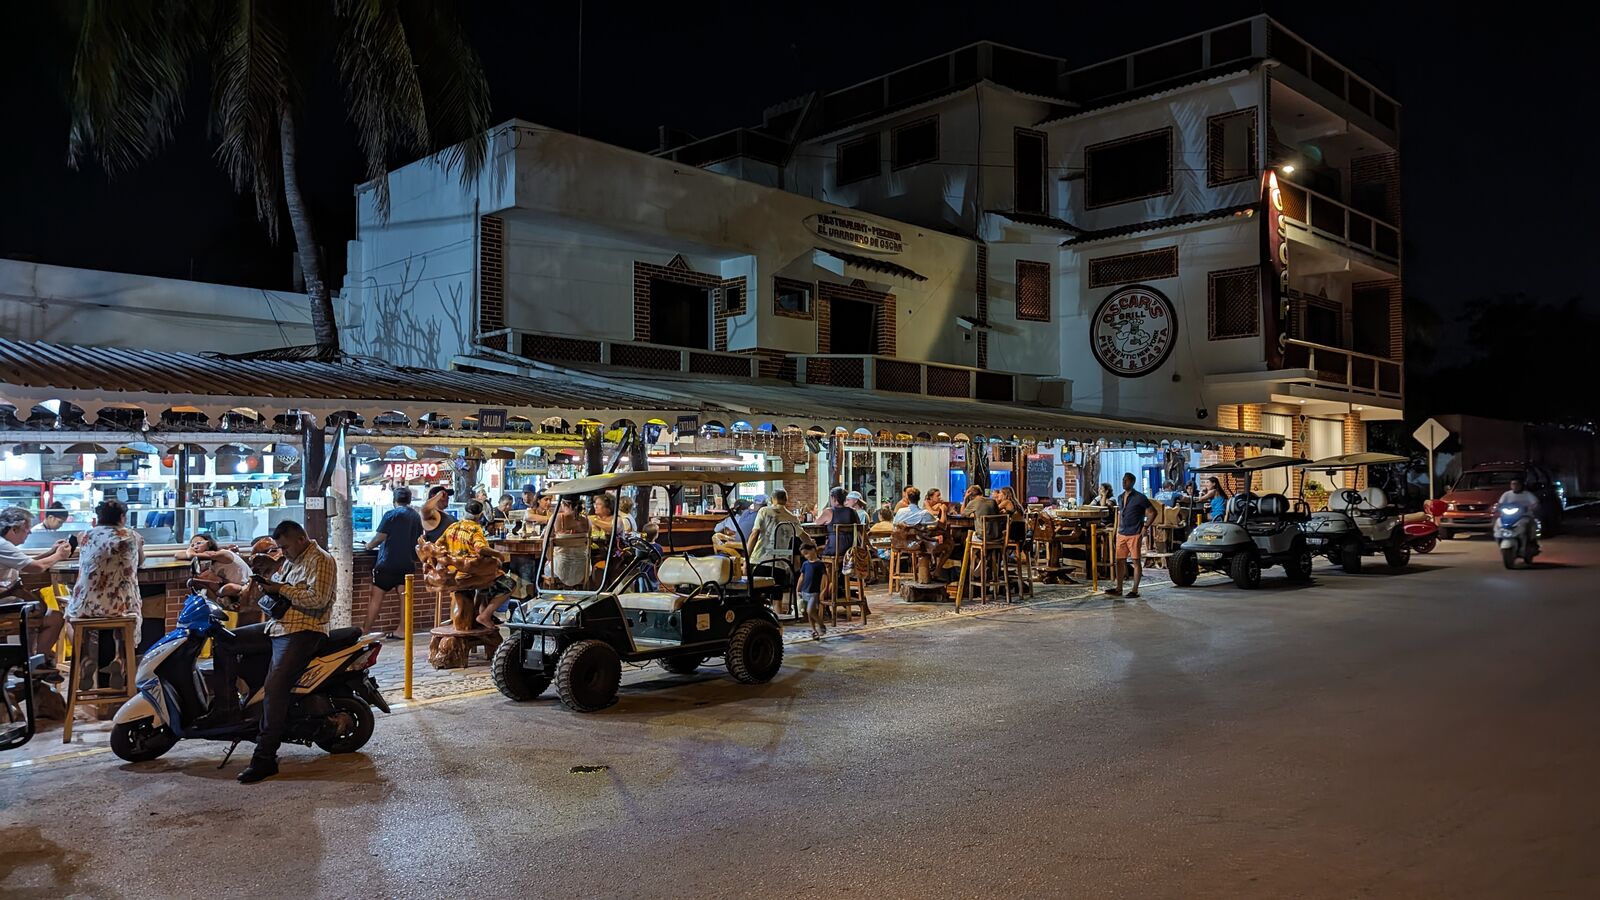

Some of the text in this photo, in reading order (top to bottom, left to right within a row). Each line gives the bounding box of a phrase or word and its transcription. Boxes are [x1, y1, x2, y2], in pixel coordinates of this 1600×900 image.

[1099, 335, 1123, 368] PIZZA
[1141, 327, 1167, 366] PASTA
[1107, 329, 1159, 360] AUTHENTIC NEW YORK
[482, 414, 501, 428] SALIDA
[679, 420, 697, 432] ENTRADA
[383, 463, 439, 481] ABIERTO
